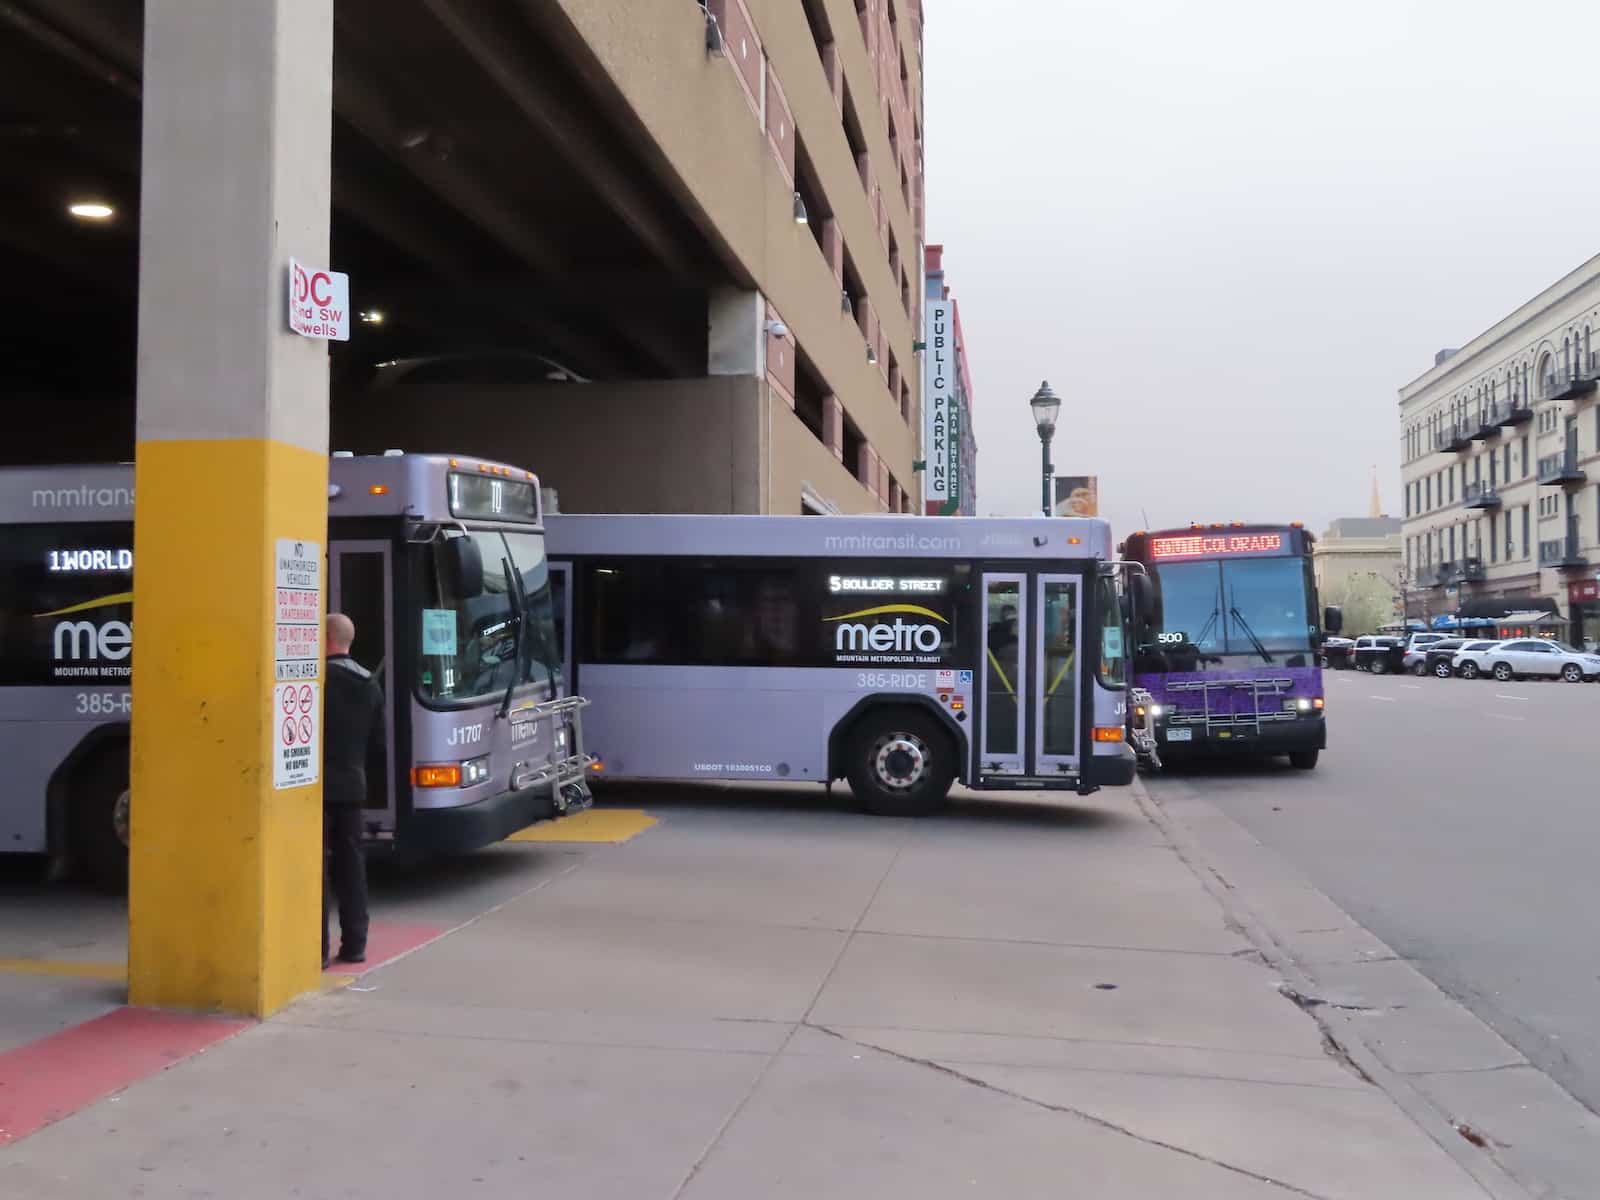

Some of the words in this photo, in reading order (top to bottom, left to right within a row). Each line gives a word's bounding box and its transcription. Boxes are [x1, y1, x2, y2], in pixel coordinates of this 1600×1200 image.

[320, 309, 342, 322] SW
[934, 309, 945, 390] PUBLIC
[949, 406, 958, 435] MAIN
[934, 398, 945, 492] PARKING
[949, 440, 958, 498] ENTRANCE
[824, 534, 961, 551] mmtransit.com
[1203, 535, 1281, 552] COLORADO
[829, 576, 840, 591] 5
[842, 579, 894, 591] BOULDER
[900, 580, 943, 591] STREET
[53, 621, 134, 660] me
[836, 618, 941, 653] metro
[1158, 632, 1183, 643] 500
[55, 667, 98, 677] MOUNTAIN
[857, 673, 927, 688] 385-RIDE
[447, 724, 483, 745] J1707
